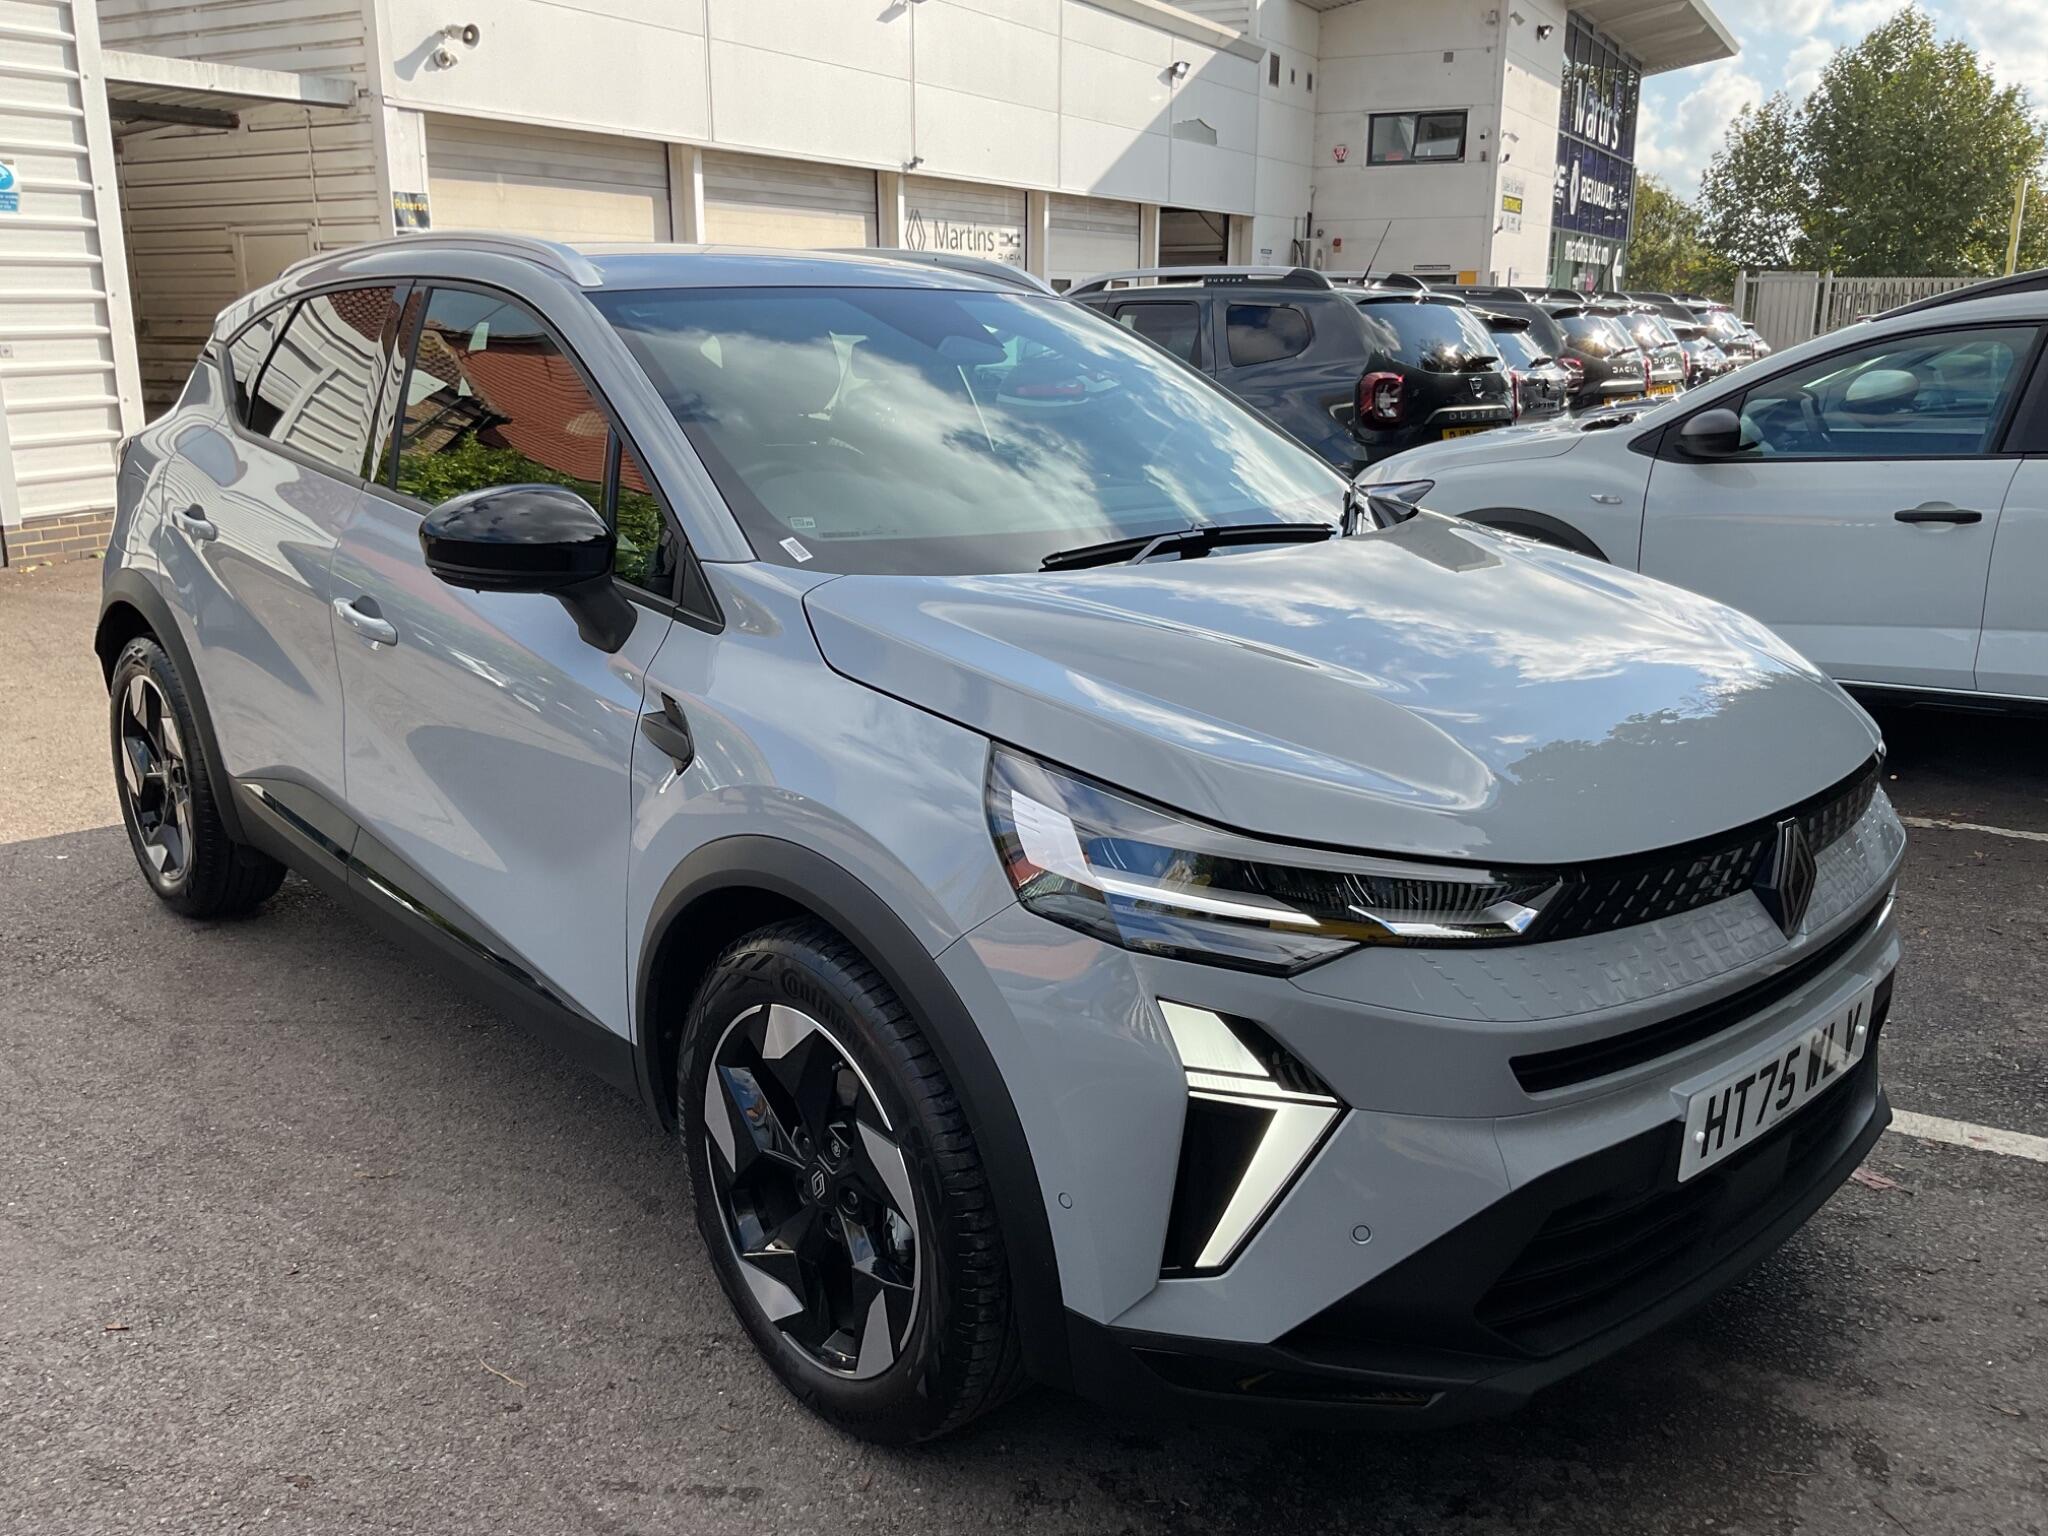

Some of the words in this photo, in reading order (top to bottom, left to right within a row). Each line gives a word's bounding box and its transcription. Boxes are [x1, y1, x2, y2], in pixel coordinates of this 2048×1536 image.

[1581, 176, 1612, 209] RENAULT
[934, 220, 994, 252] Martins
[1612, 366, 1638, 374] DACIA
[1700, 1045, 1801, 1160] HT75
